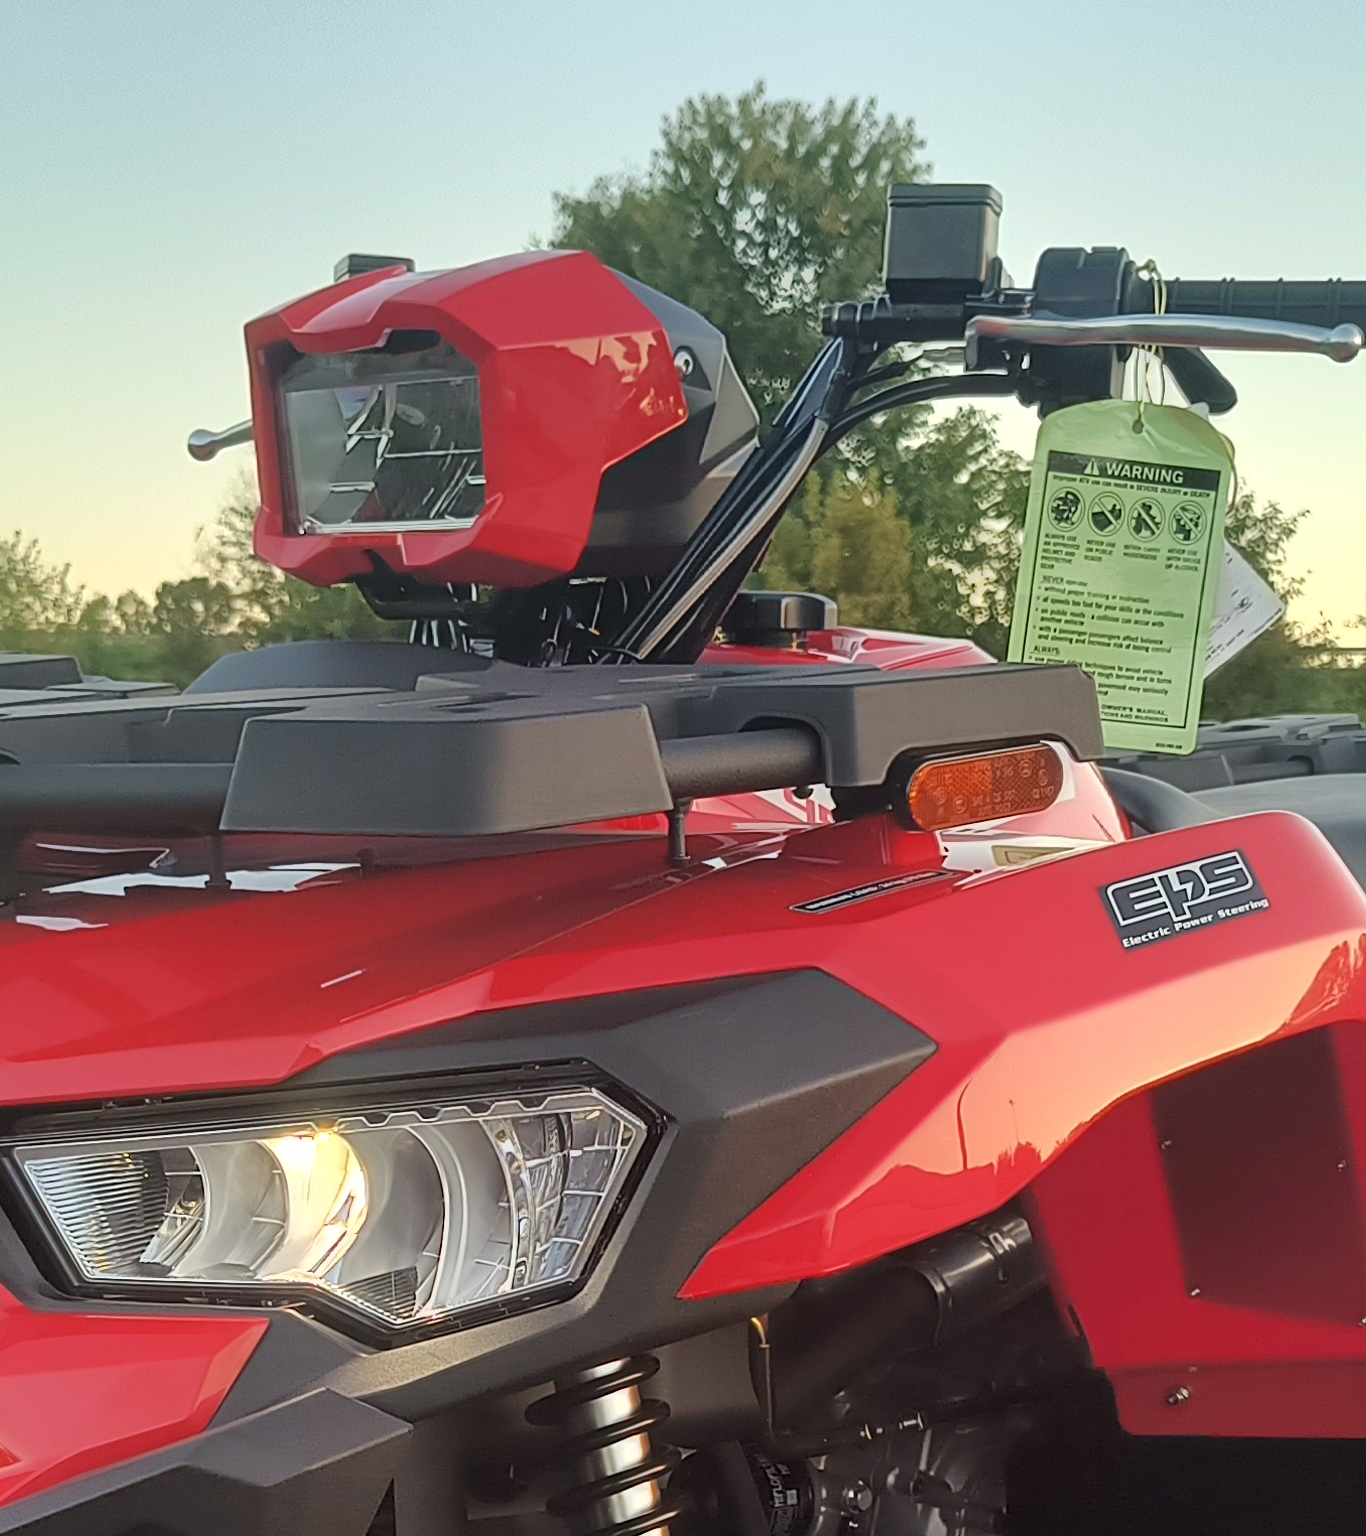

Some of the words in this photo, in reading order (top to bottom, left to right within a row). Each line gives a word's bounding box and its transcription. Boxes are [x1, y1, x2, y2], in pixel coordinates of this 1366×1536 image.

[1104, 461, 1184, 484] WARNING
[1107, 851, 1254, 926] EPS
[1121, 926, 1172, 949] Electric
[1173, 913, 1214, 932] Power
[1217, 898, 1270, 919] Steering
